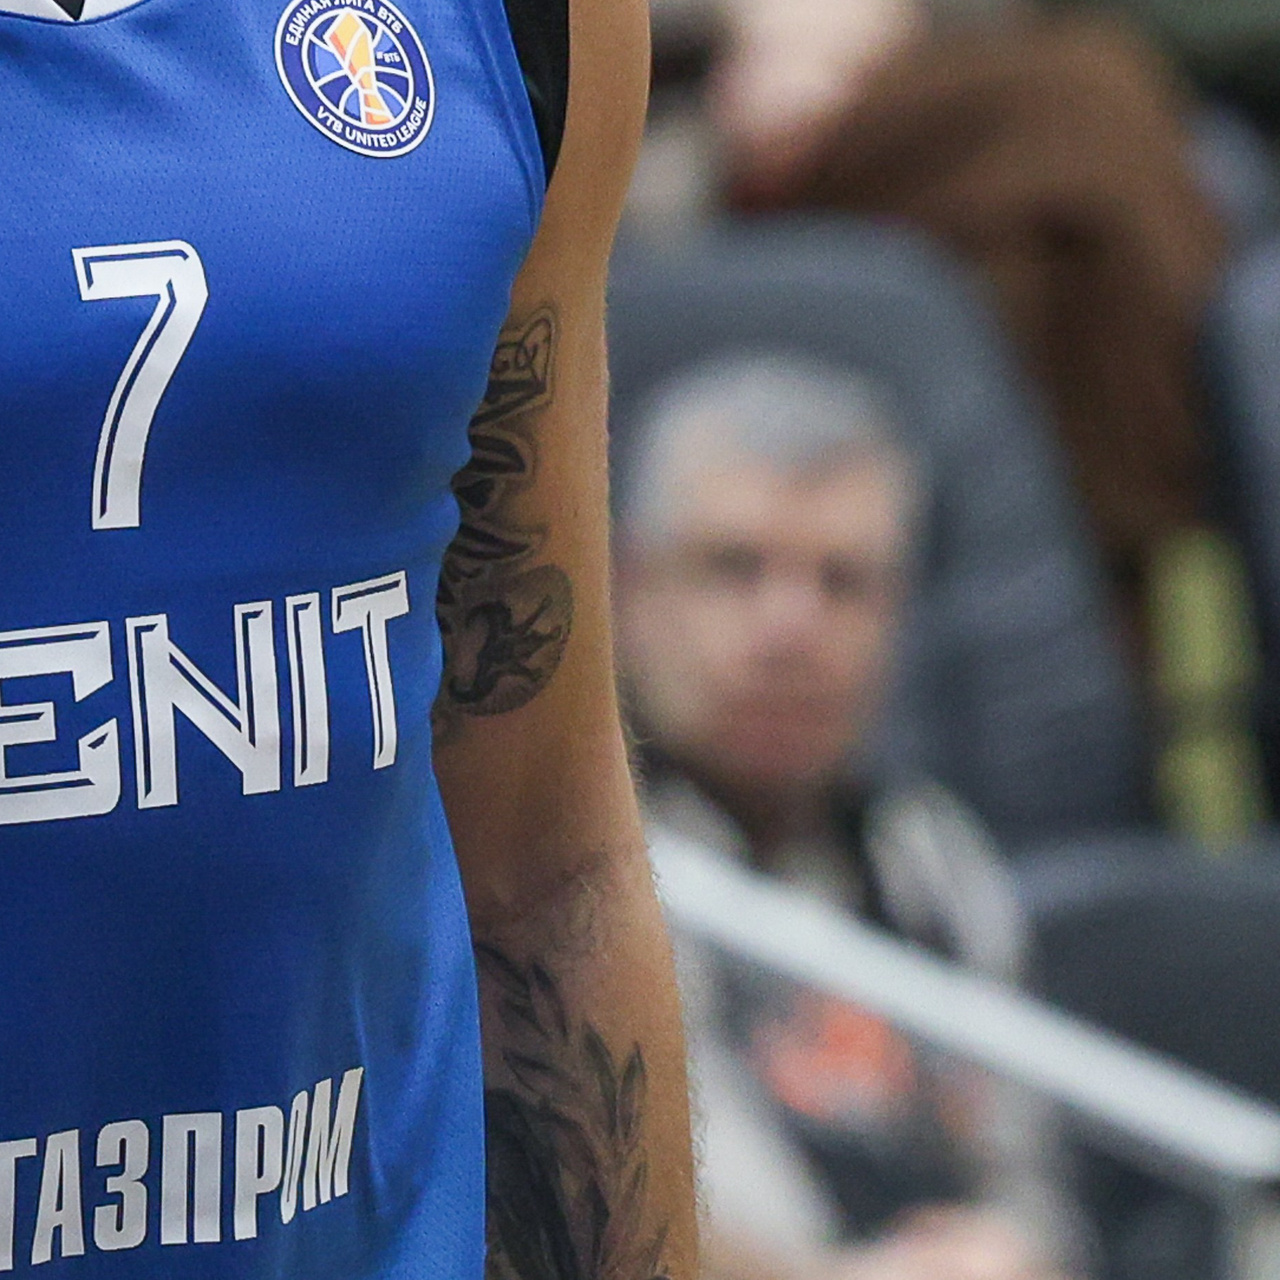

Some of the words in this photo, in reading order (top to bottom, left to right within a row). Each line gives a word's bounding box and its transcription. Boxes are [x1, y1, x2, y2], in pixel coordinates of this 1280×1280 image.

[377, 6, 404, 34] ВТБ
[317, 105, 343, 133] VTB
[345, 127, 398, 148] UNITED
[396, 96, 427, 143] LEAGUE
[71, 239, 209, 530] 7
